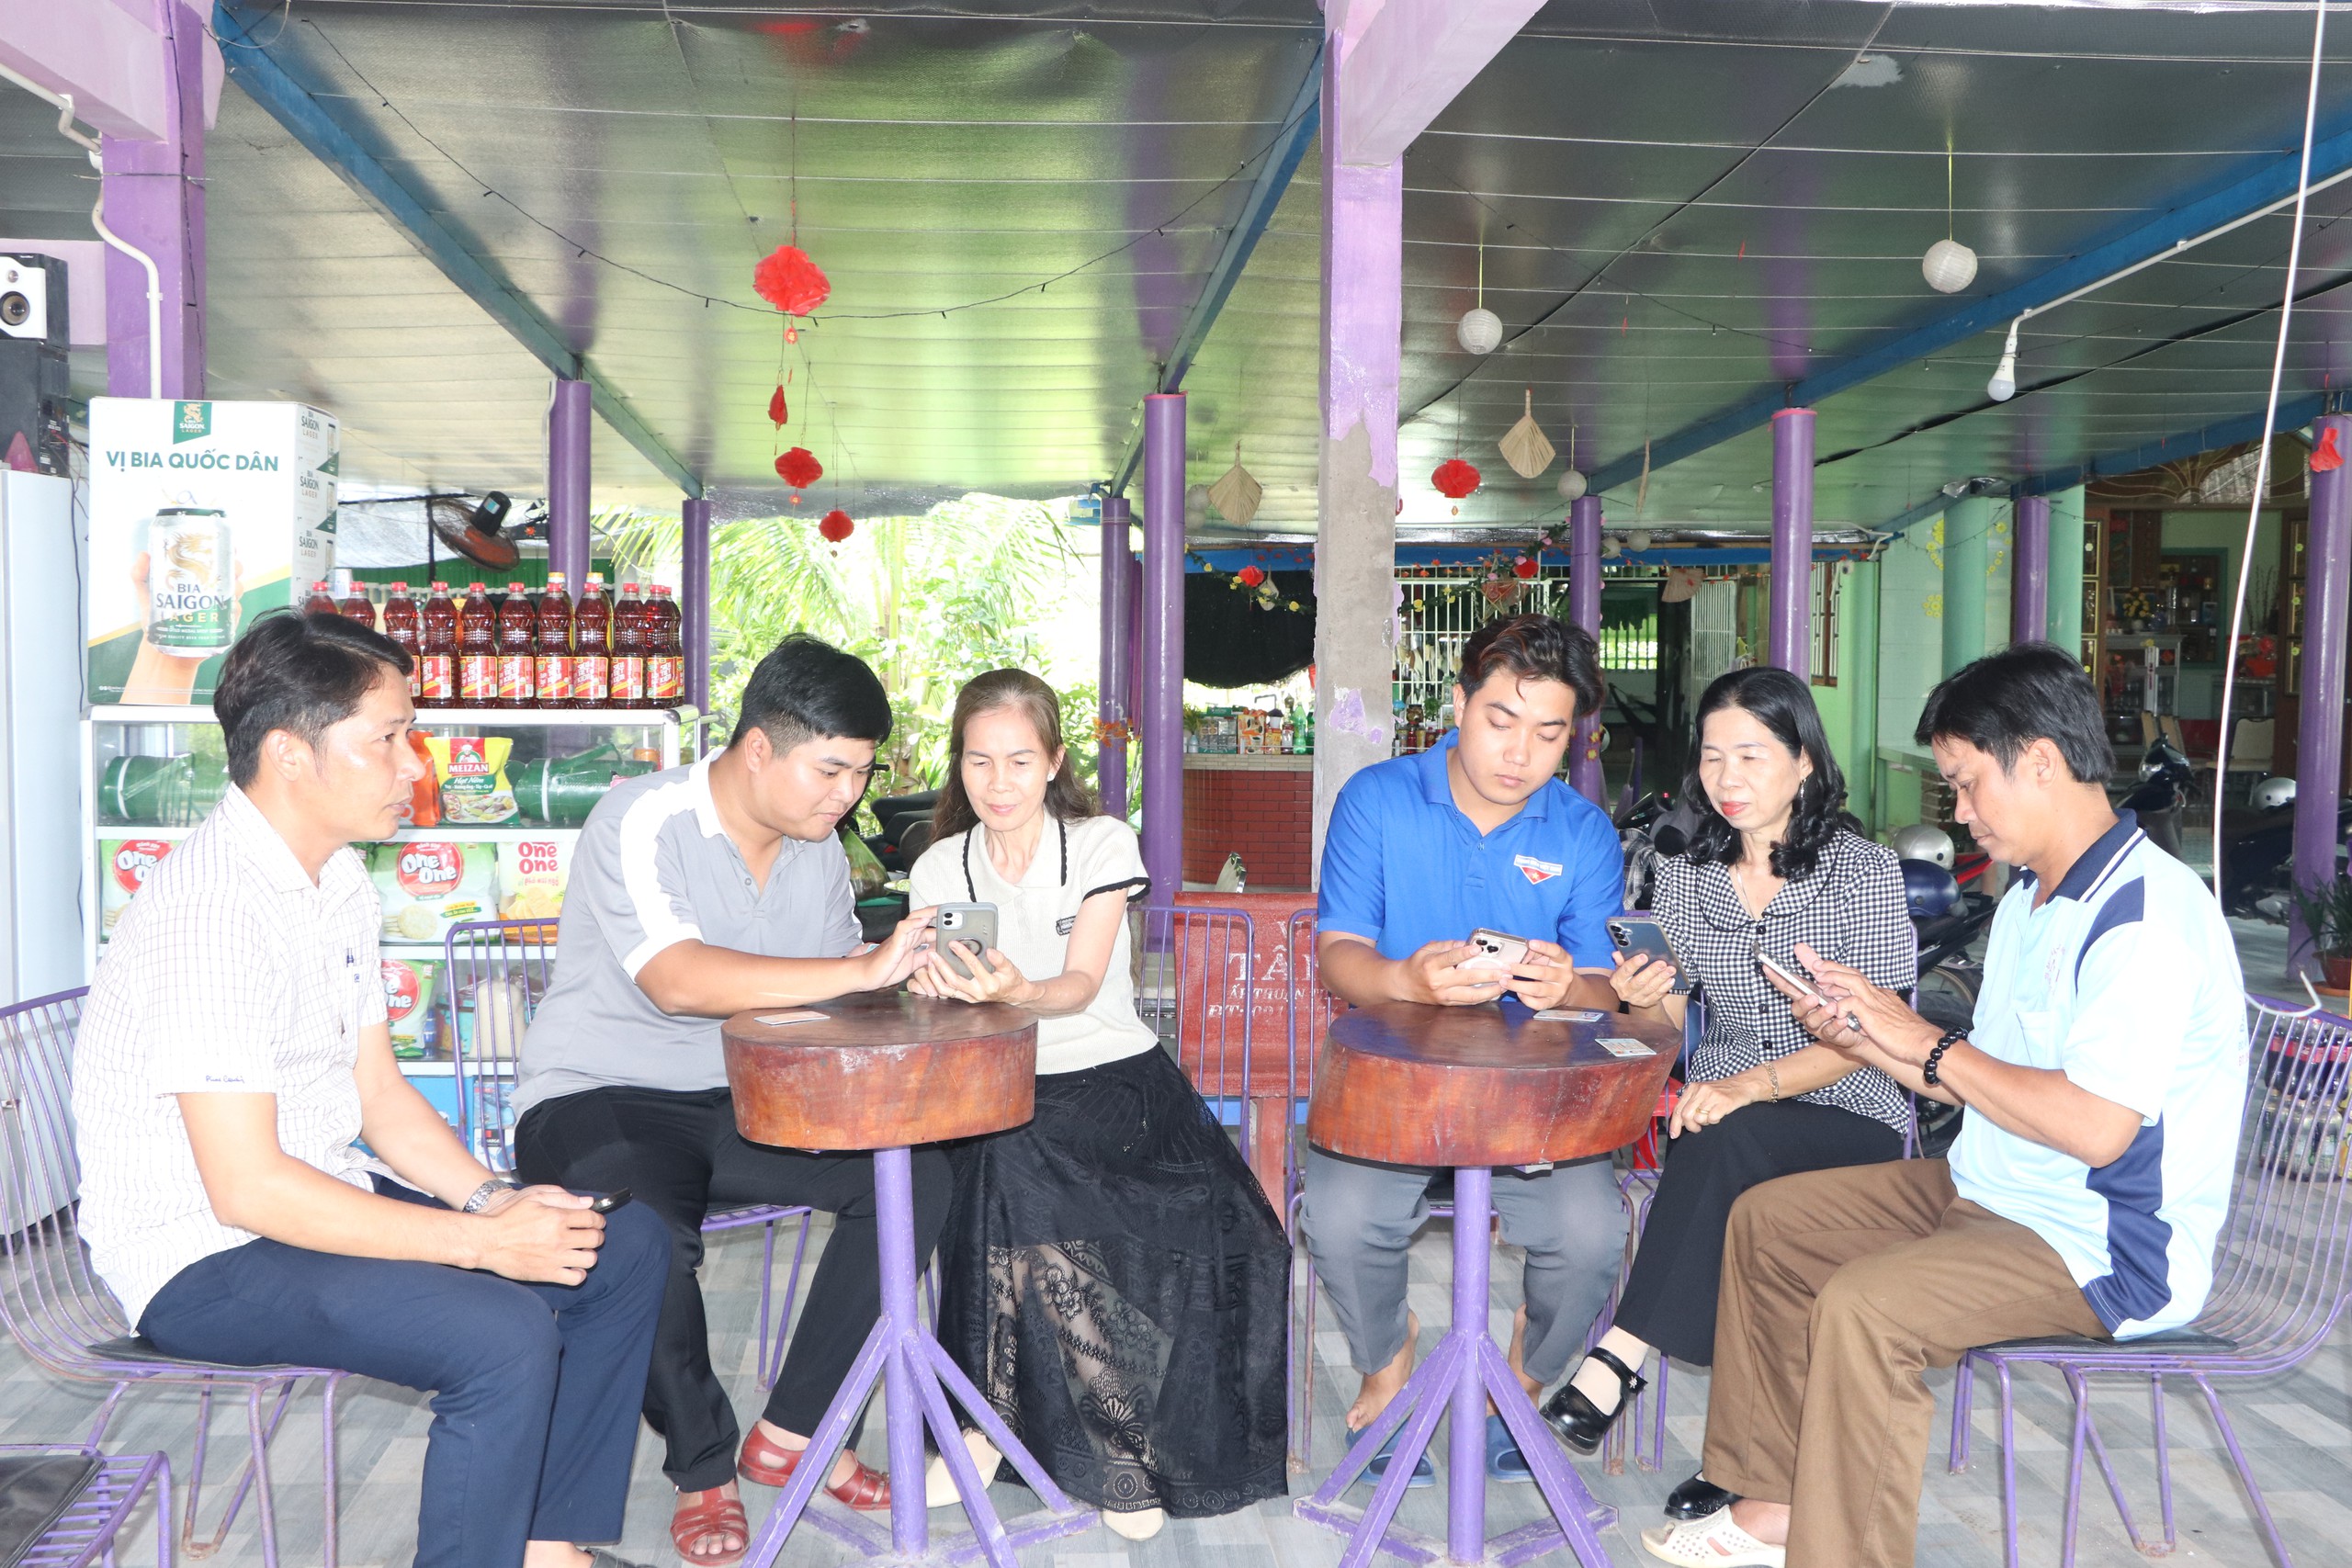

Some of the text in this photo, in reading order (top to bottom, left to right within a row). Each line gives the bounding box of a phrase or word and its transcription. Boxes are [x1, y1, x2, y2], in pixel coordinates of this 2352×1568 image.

[106, 448, 278, 472] VỊ BIA QUỐC DÂN
[177, 583, 200, 593] BIA
[156, 592, 225, 611] SAIGON
[448, 763, 489, 773] MEIZAN
[518, 841, 558, 858] One
[117, 849, 159, 872] One
[401, 853, 440, 874] One
[519, 858, 559, 874] One
[418, 865, 458, 885] One
[386, 994, 413, 1009] ne
[1252, 987, 1306, 1002] THUN
